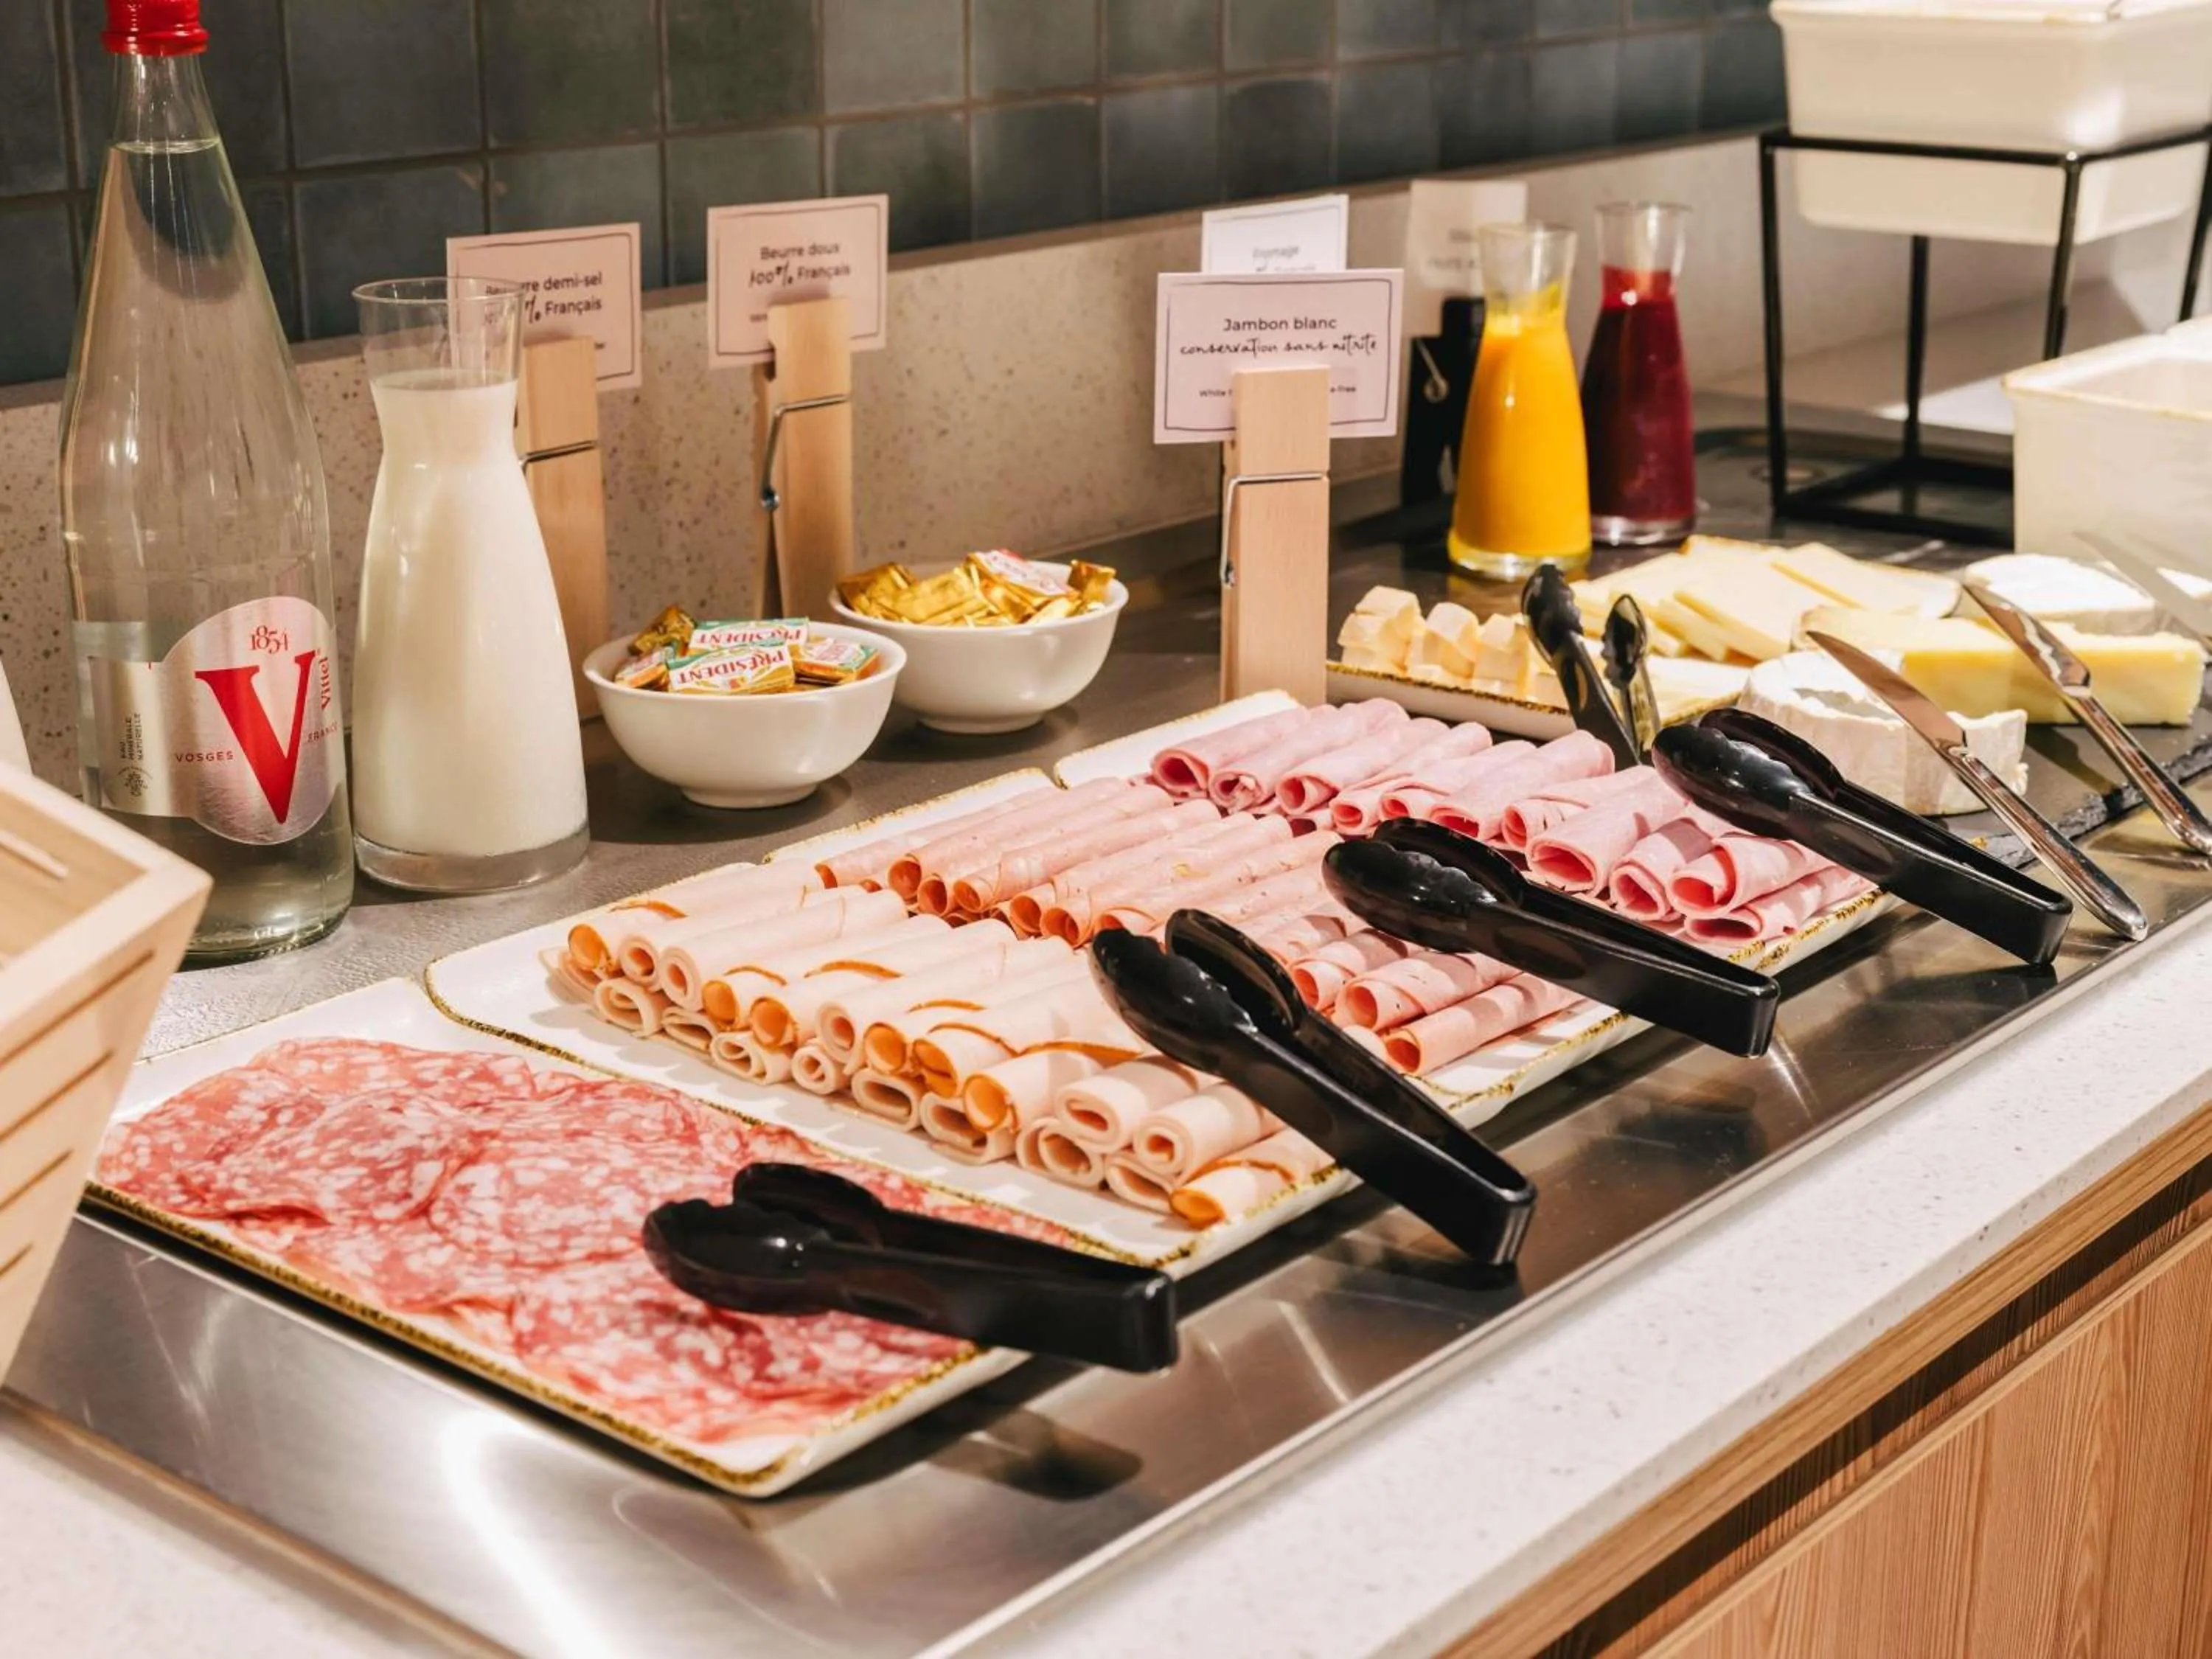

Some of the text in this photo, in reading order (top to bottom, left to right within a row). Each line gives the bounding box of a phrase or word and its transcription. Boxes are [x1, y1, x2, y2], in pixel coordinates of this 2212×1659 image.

[760, 243, 839, 260] Beurre doux
[543, 272, 602, 291] demi-sel
[748, 260, 852, 288] 100% Français
[545, 296, 602, 316] Français
[1223, 316, 1337, 331] Jambon blanc
[1180, 332, 1377, 358] conservation sans nitrite
[250, 625, 288, 654] 1854
[319, 655, 331, 710] Vittel
[195, 650, 316, 824] V
[175, 751, 234, 762] VOSGES
